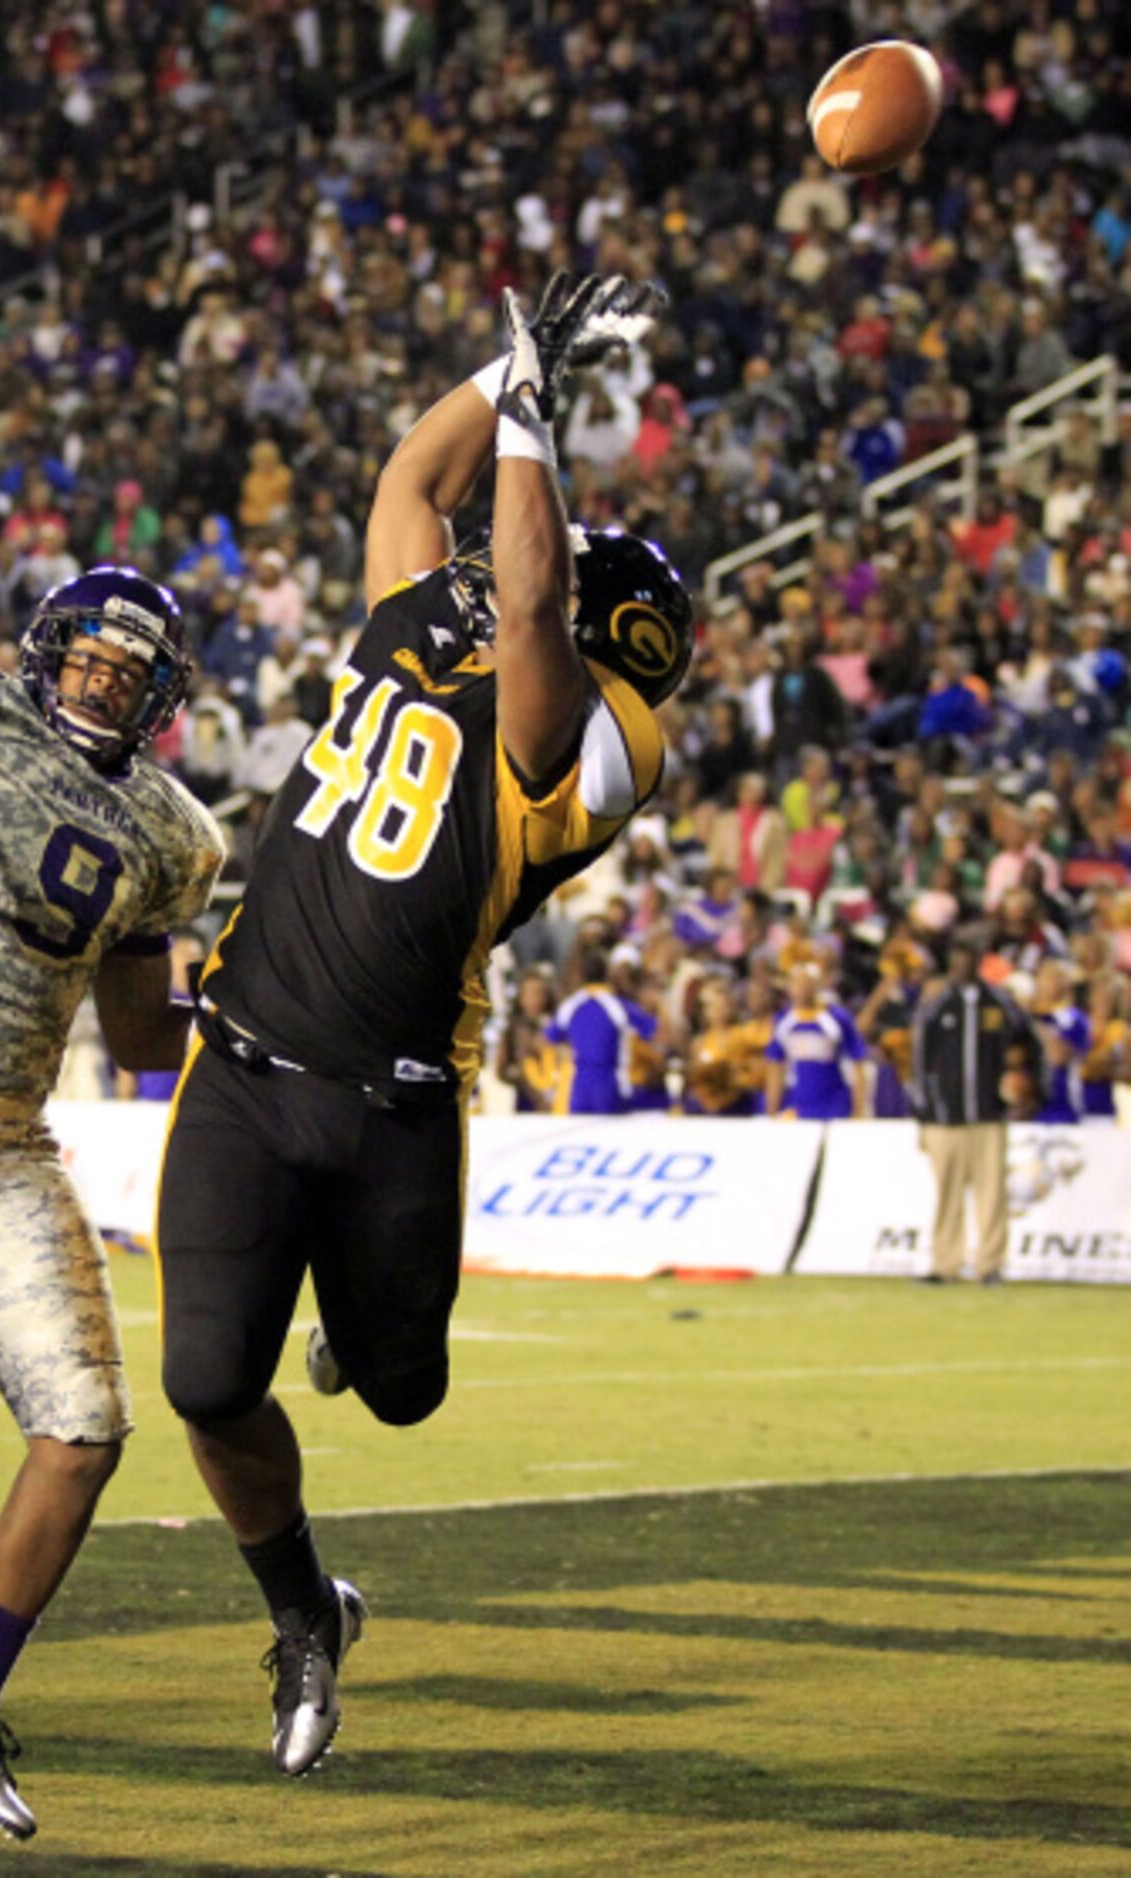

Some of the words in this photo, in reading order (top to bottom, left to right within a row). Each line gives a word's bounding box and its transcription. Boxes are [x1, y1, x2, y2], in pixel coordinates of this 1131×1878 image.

[294, 665, 462, 880] 48
[18, 823, 125, 960] 9
[478, 1184, 720, 1222] LIGHT
[534, 1145, 714, 1184] BUD
